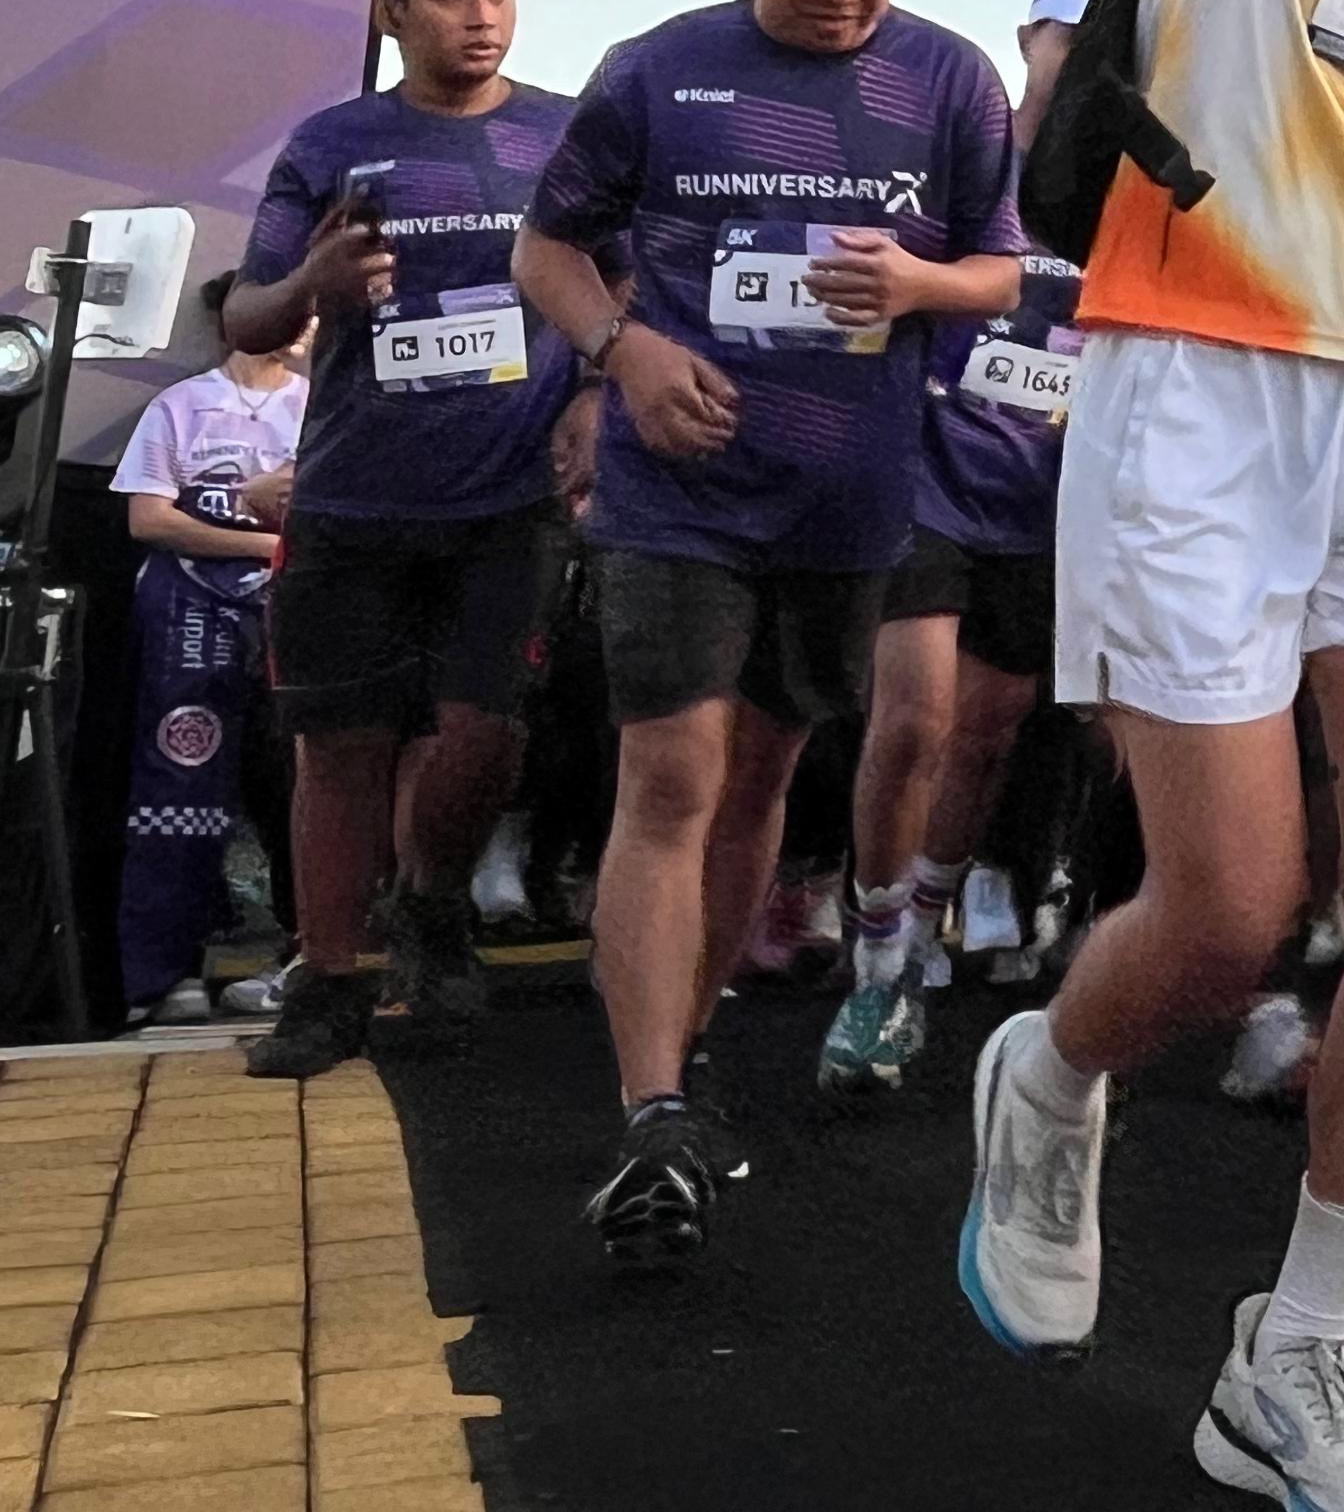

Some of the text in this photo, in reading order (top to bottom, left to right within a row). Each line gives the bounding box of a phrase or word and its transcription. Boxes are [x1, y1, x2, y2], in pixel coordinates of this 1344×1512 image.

[675, 174, 893, 202] RUNNIVERSARY
[380, 212, 524, 235] NIVERSARY
[435, 330, 496, 359] 1017
